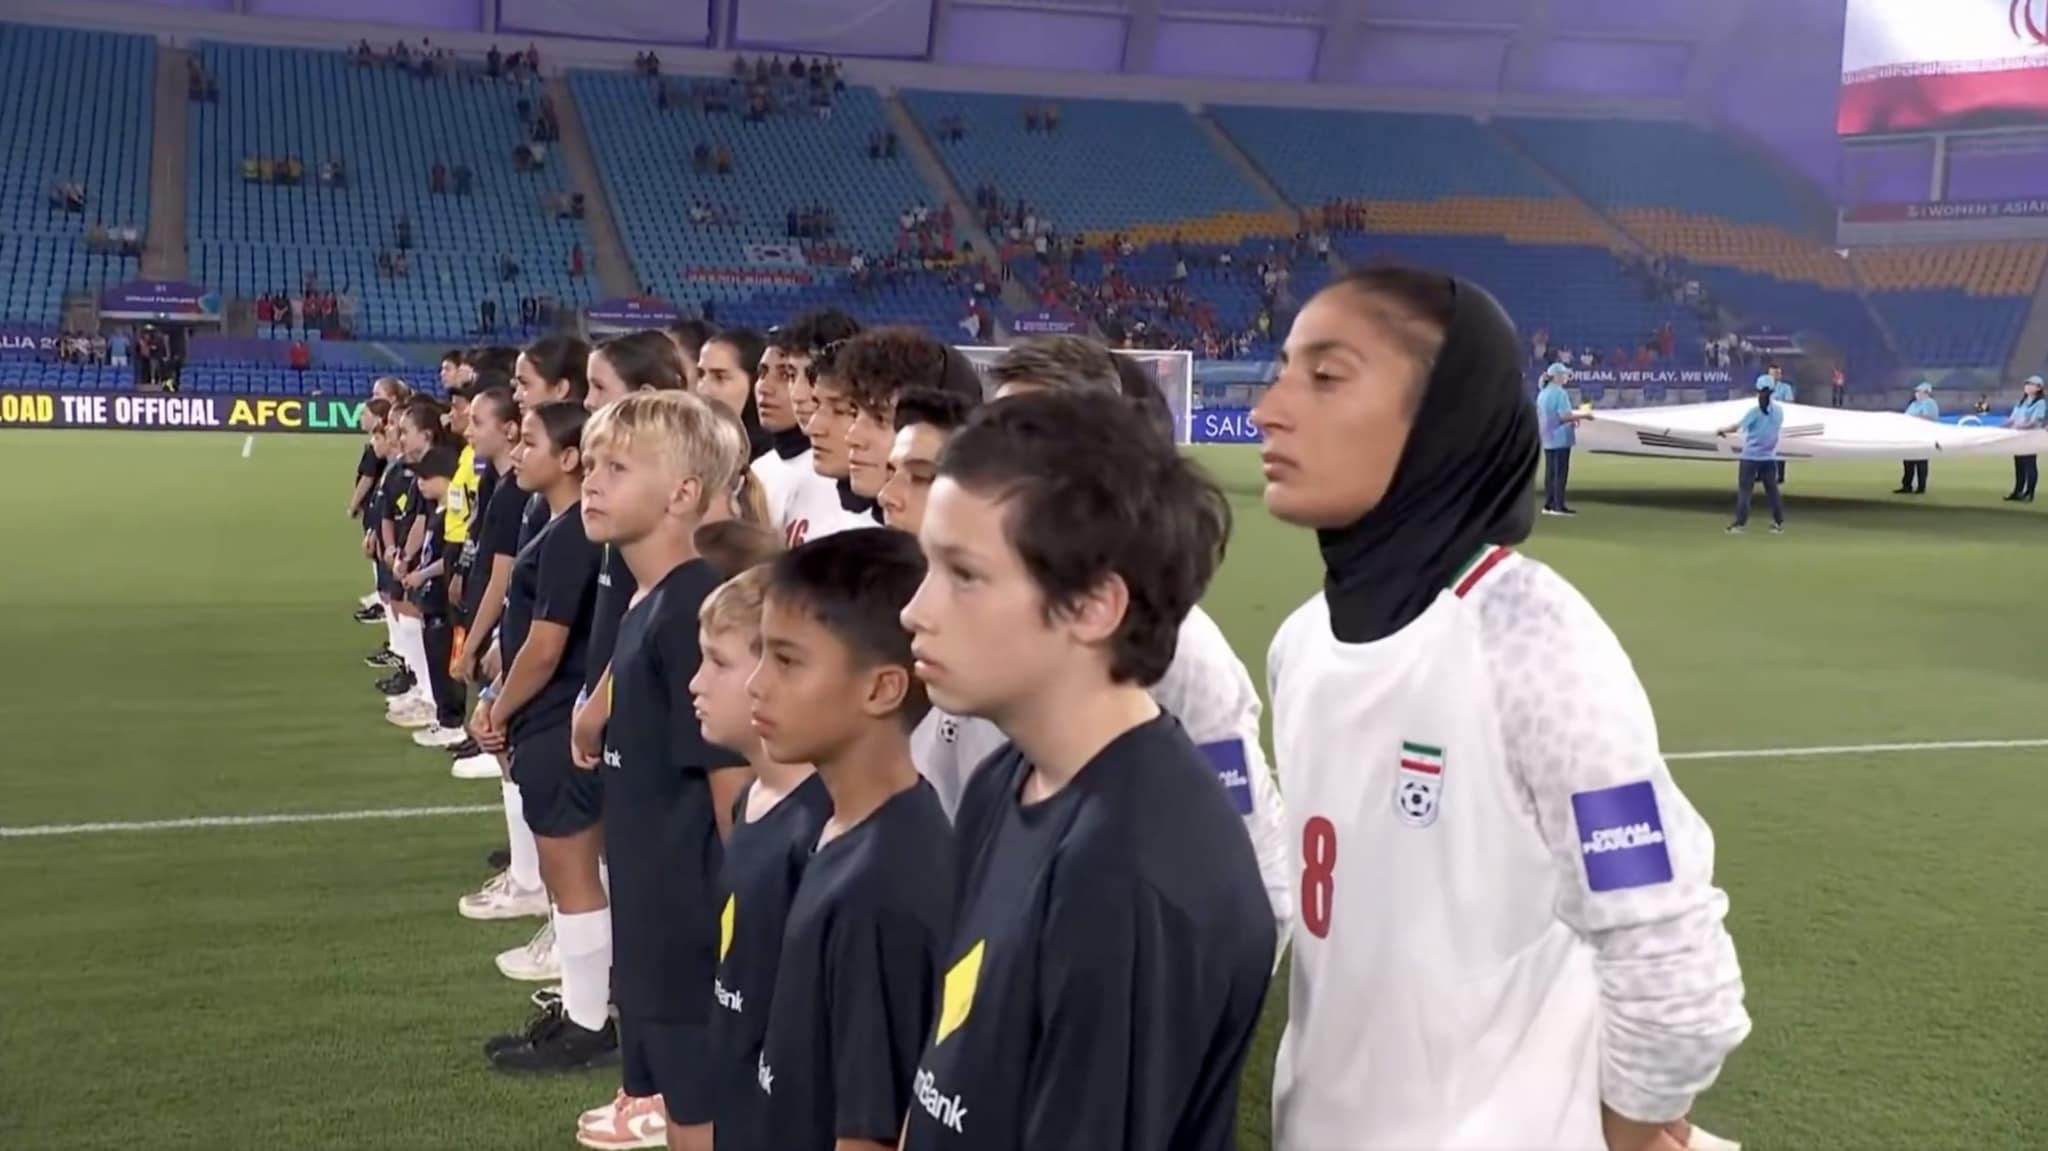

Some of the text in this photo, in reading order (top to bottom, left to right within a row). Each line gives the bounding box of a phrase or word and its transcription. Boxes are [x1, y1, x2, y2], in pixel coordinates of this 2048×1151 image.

[0, 335, 36, 349] LIA
[0, 394, 53, 422] OAD
[61, 396, 107, 423] THE
[115, 397, 220, 425] OFFICIAL
[228, 399, 302, 427] AFC
[1301, 816, 1337, 939] 8
